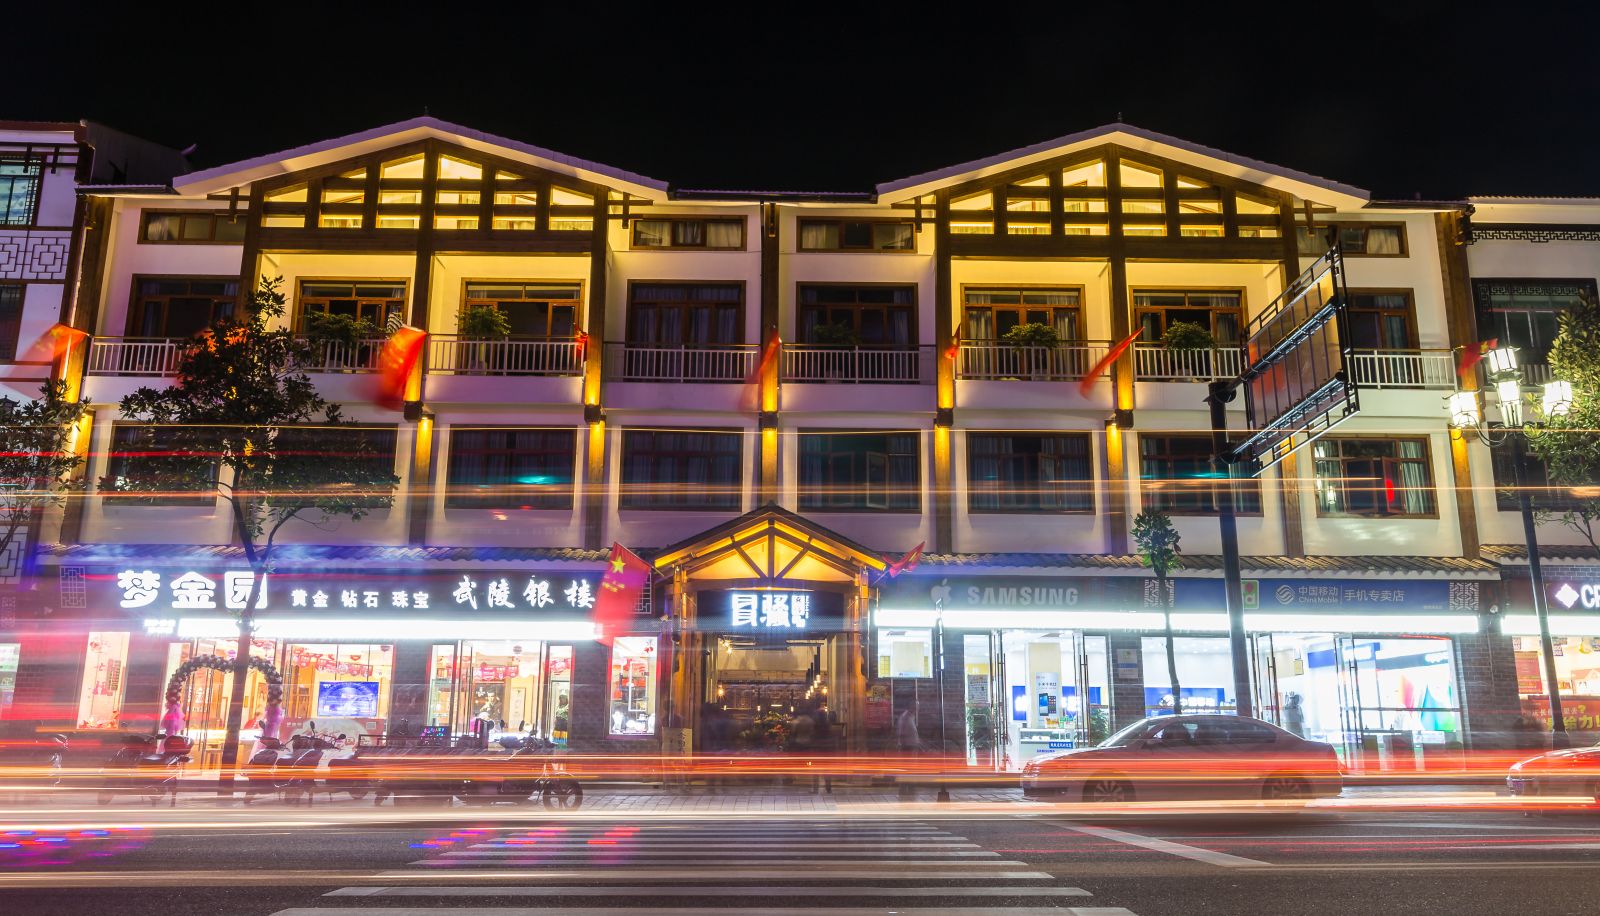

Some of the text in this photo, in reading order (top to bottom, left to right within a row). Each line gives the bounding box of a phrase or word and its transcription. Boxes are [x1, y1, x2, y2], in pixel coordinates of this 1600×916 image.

[117, 570, 268, 609] 梦金园
[291, 589, 429, 609] 黄金 钻石 珠宝
[452, 575, 596, 610] 武陵银楼
[967, 586, 1079, 606] SAMSUNG
[1298, 585, 1339, 597] 中国移动
[1344, 589, 1405, 602] 手机专卖店
